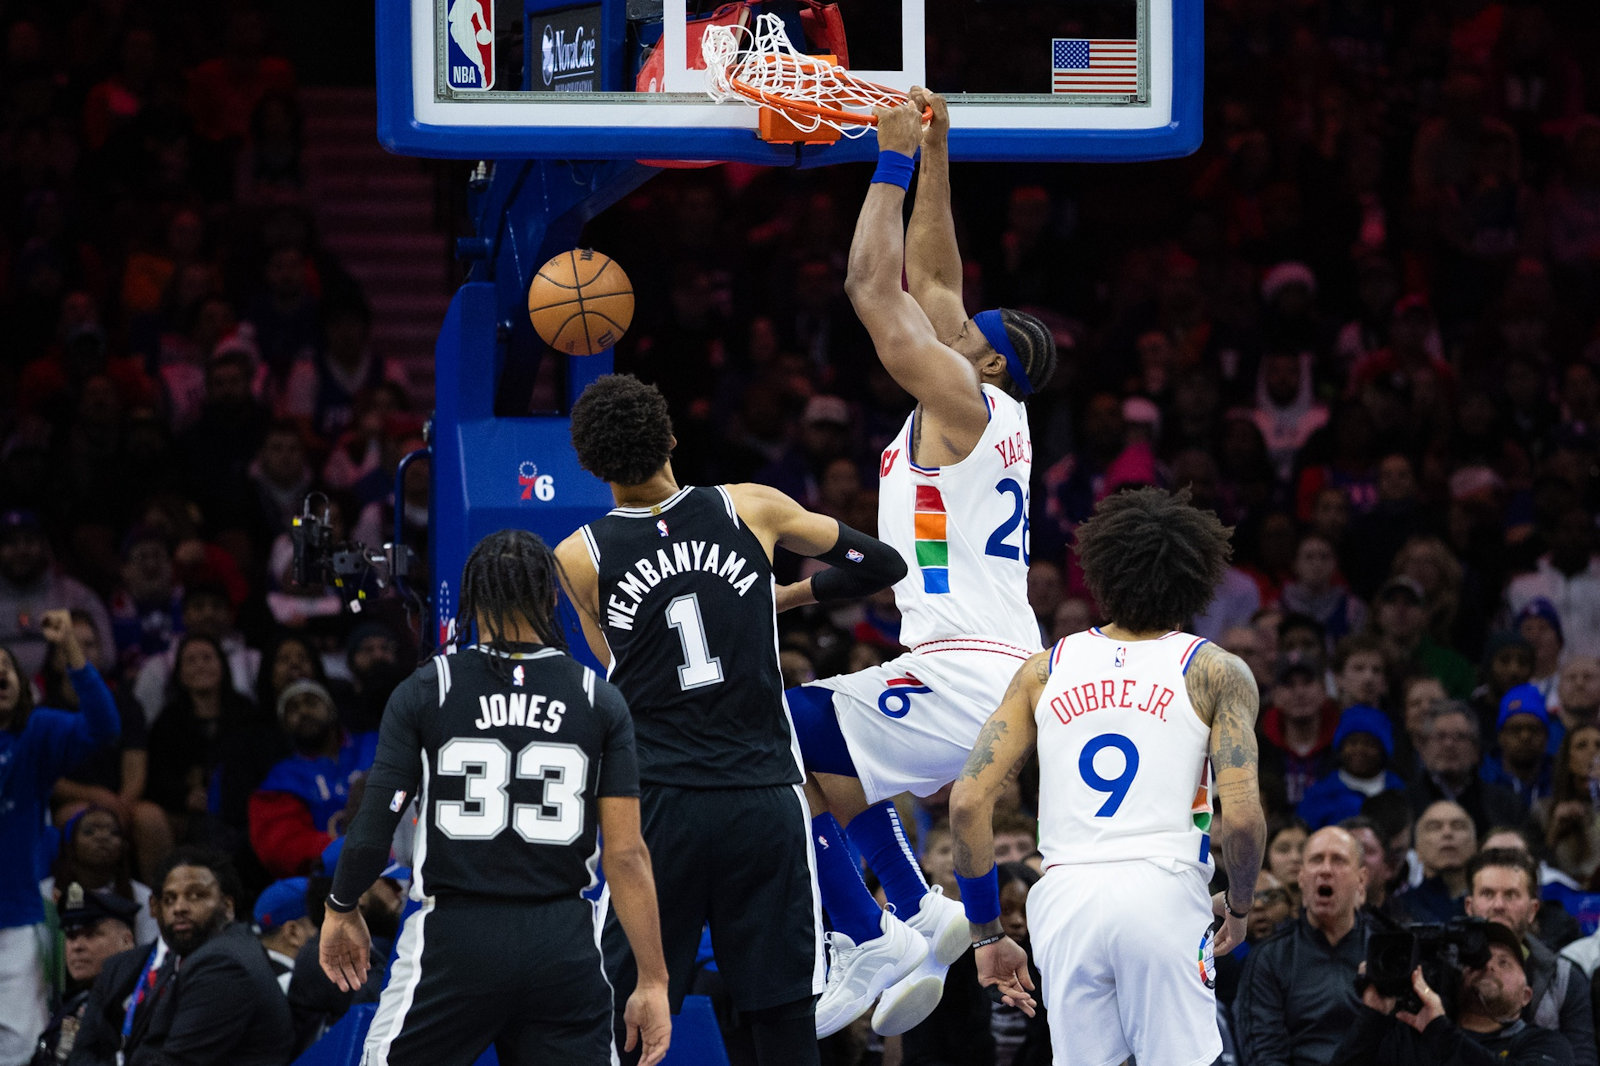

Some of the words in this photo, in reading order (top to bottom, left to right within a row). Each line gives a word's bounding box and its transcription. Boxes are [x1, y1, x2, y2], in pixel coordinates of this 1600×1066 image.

[553, 27, 596, 72] NovaCare
[453, 66, 477, 84] NBA
[518, 473, 556, 502] 76
[606, 540, 760, 631] WEMBANYAMA
[664, 592, 725, 691] 1
[475, 693, 567, 734] JONES
[1050, 679, 1137, 725] OUBRE
[1137, 683, 1175, 723] JR.
[435, 737, 589, 846] 33
[1078, 733, 1140, 818] 9
